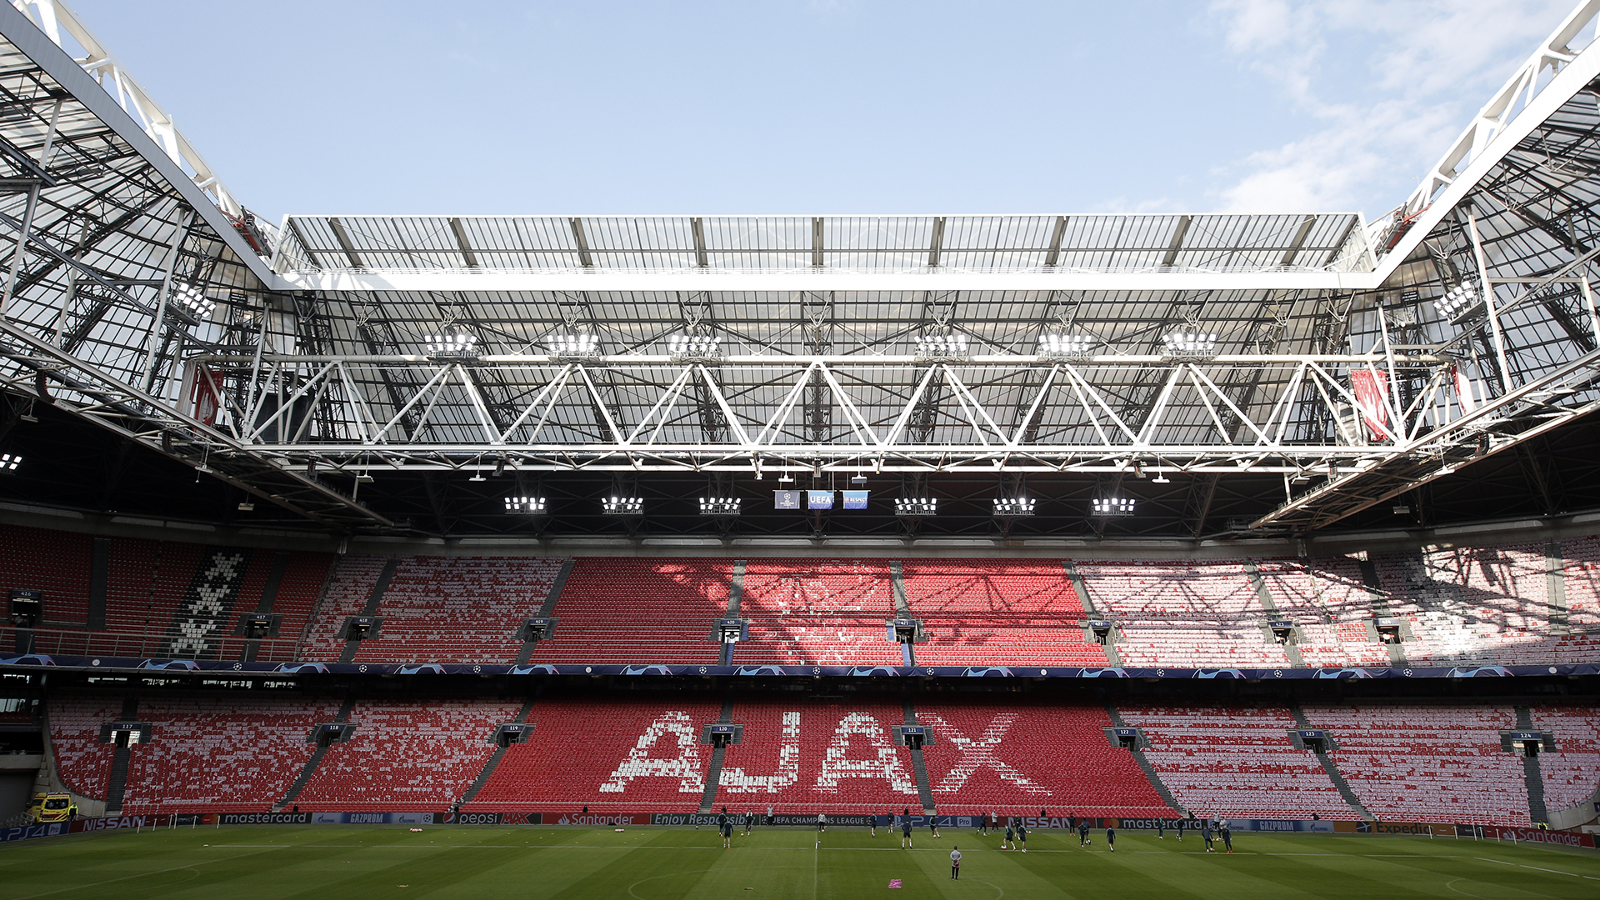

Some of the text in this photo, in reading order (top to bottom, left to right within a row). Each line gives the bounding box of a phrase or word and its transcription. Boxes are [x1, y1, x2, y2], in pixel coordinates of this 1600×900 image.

[810, 496, 831, 504] UEFA
[600, 710, 1052, 796] AJAX
[83, 815, 146, 831] NISSAN
[224, 812, 307, 823] mastercard
[350, 813, 383, 823] GAZPROM
[460, 813, 531, 824] pepsi MAX
[571, 813, 634, 825] Santander
[655, 813, 686, 826] Enjoy
[1260, 821, 1294, 831] GAZPROM
[7, 825, 45, 840] PS4
[1518, 828, 1581, 846] Santander
